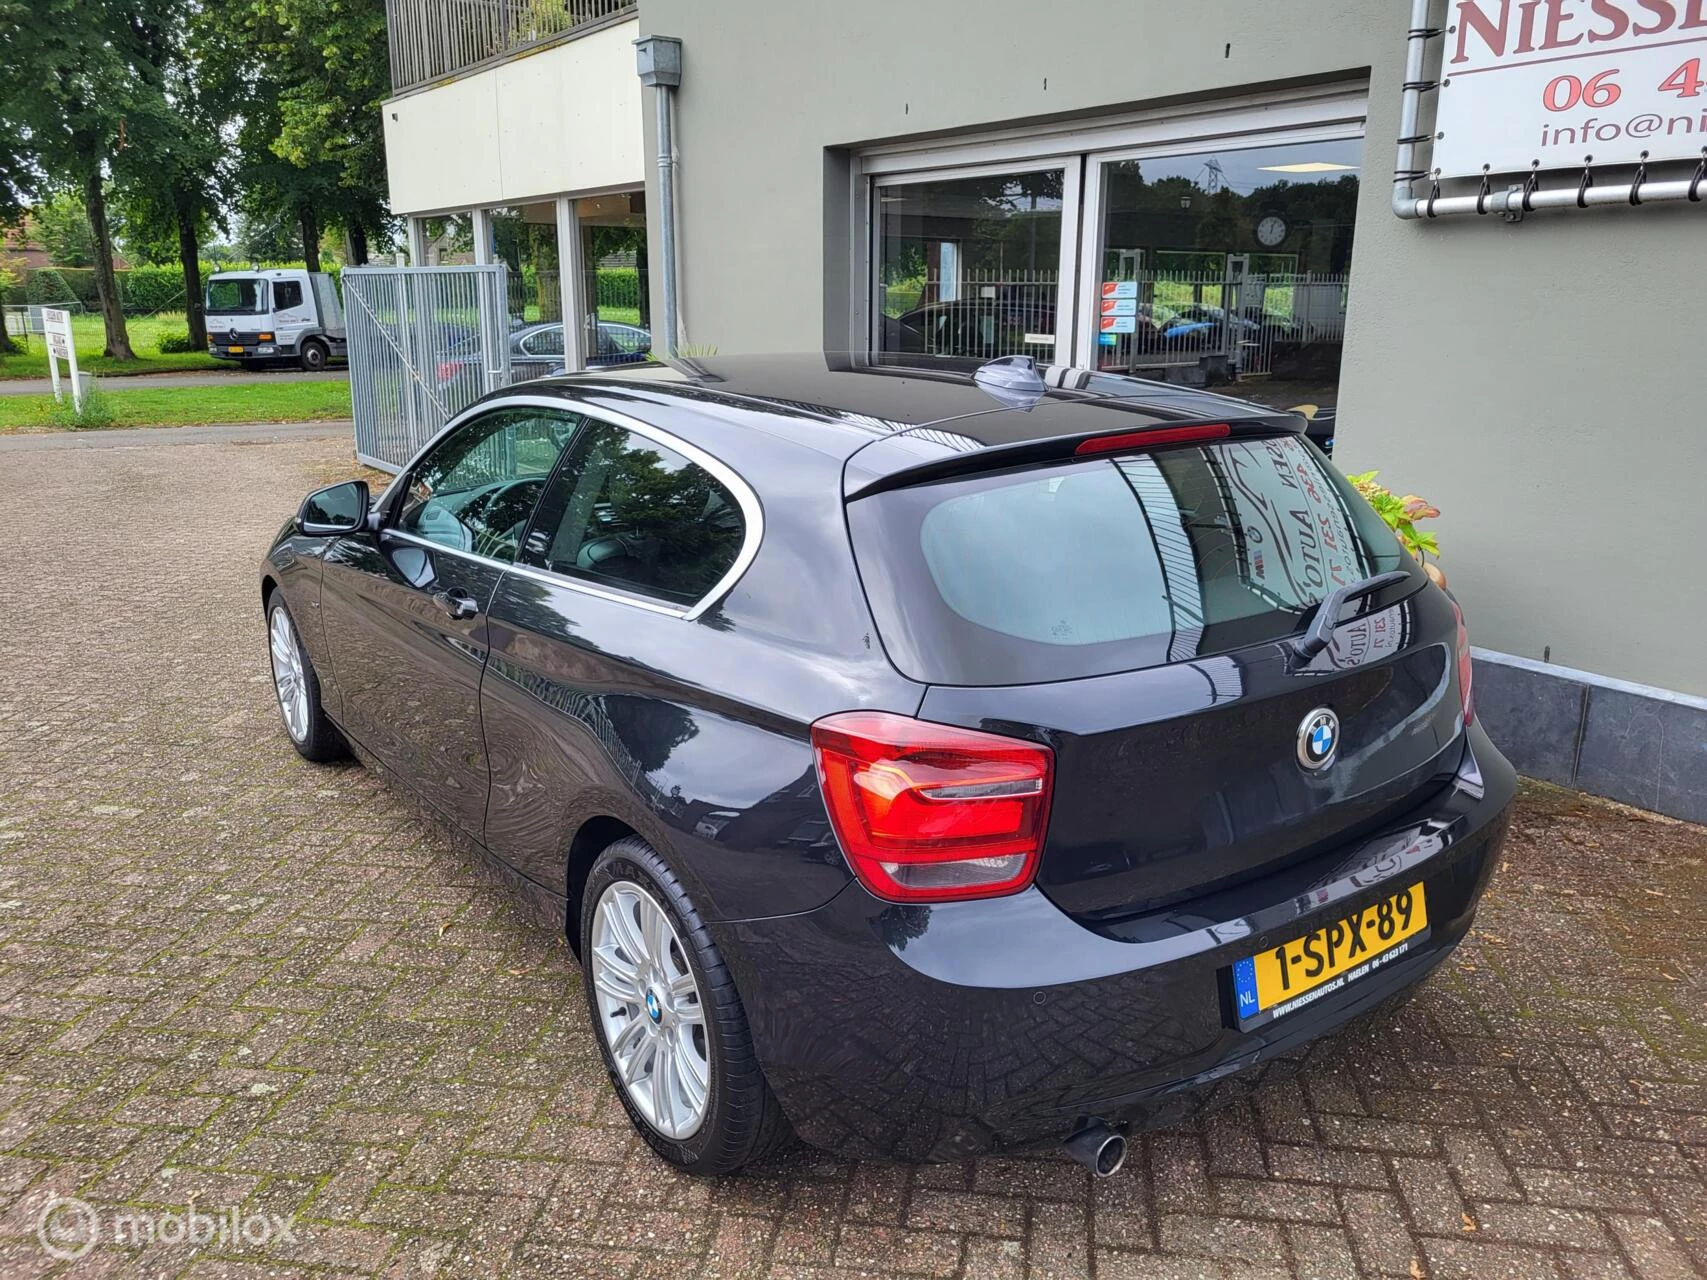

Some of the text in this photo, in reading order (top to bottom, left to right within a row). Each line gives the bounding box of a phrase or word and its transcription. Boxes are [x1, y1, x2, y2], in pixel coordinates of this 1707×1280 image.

[1543, 69, 1621, 112] 06
[1275, 890, 1413, 990] 1-SPX-89
[1347, 964, 1370, 982] HAELEN
[1240, 991, 1255, 1007] NL
